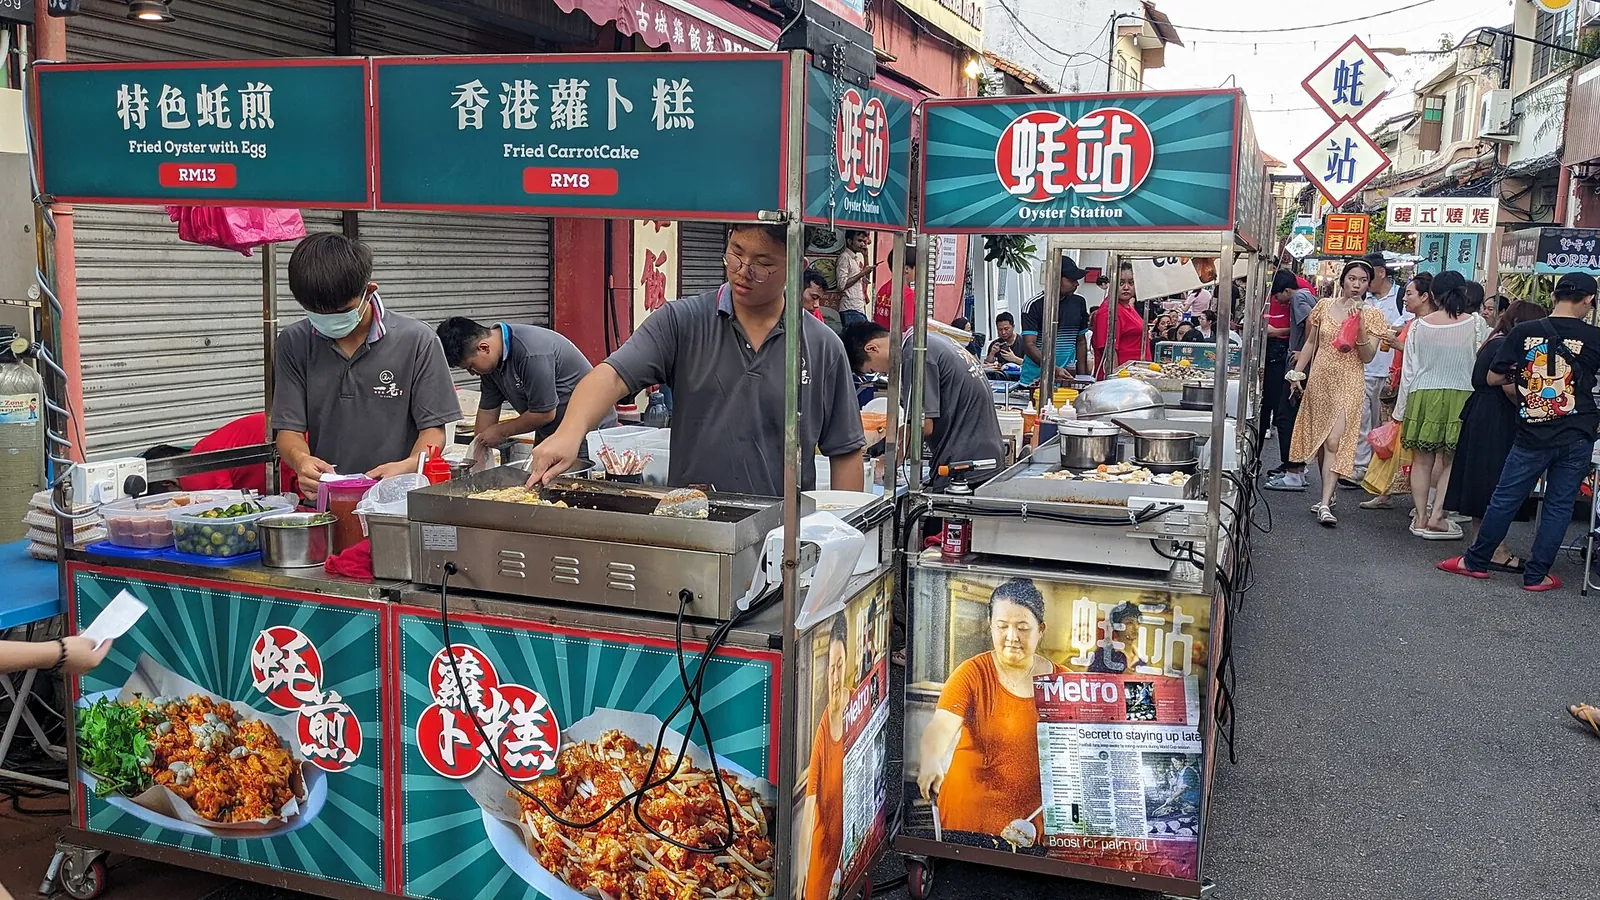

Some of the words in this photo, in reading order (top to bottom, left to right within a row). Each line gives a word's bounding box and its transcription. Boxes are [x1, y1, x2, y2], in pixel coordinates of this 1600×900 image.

[116, 81, 275, 130] 特色蚝煎
[450, 77, 695, 131] 香港蘿卜糕
[1324, 58, 1365, 184] 蚝站
[128, 140, 162, 153] Fried
[164, 140, 206, 157] Oyster
[208, 140, 239, 154] with
[241, 140, 267, 158] Egg
[503, 143, 544, 158] Fried
[547, 143, 640, 159] CarrotCake
[841, 96, 883, 188] 蚝站
[1010, 114, 1133, 195] 蚝站
[178, 168, 216, 182] RM13
[550, 173, 590, 188] RM8
[844, 198, 862, 214] Oyster
[862, 199, 880, 214] Station
[1018, 206, 1066, 221] Oyster
[1070, 205, 1123, 218] Station
[1394, 207, 1490, 225] 韓式燒烤
[1547, 253, 1600, 268] KOREA
[1070, 596, 1195, 677] 蚝站
[252, 629, 358, 763] 蚝煎
[1043, 675, 1118, 703] Metro
[845, 684, 869, 733] Metro
[1078, 728, 1111, 740] Secret
[1113, 730, 1123, 740] to
[1125, 729, 1163, 743] staying
[1165, 732, 1179, 743] up
[1181, 731, 1202, 742] late
[1049, 836, 1080, 849] Boost
[1083, 836, 1098, 849] for
[1101, 837, 1132, 852] palm
[1134, 839, 1149, 851] oil
